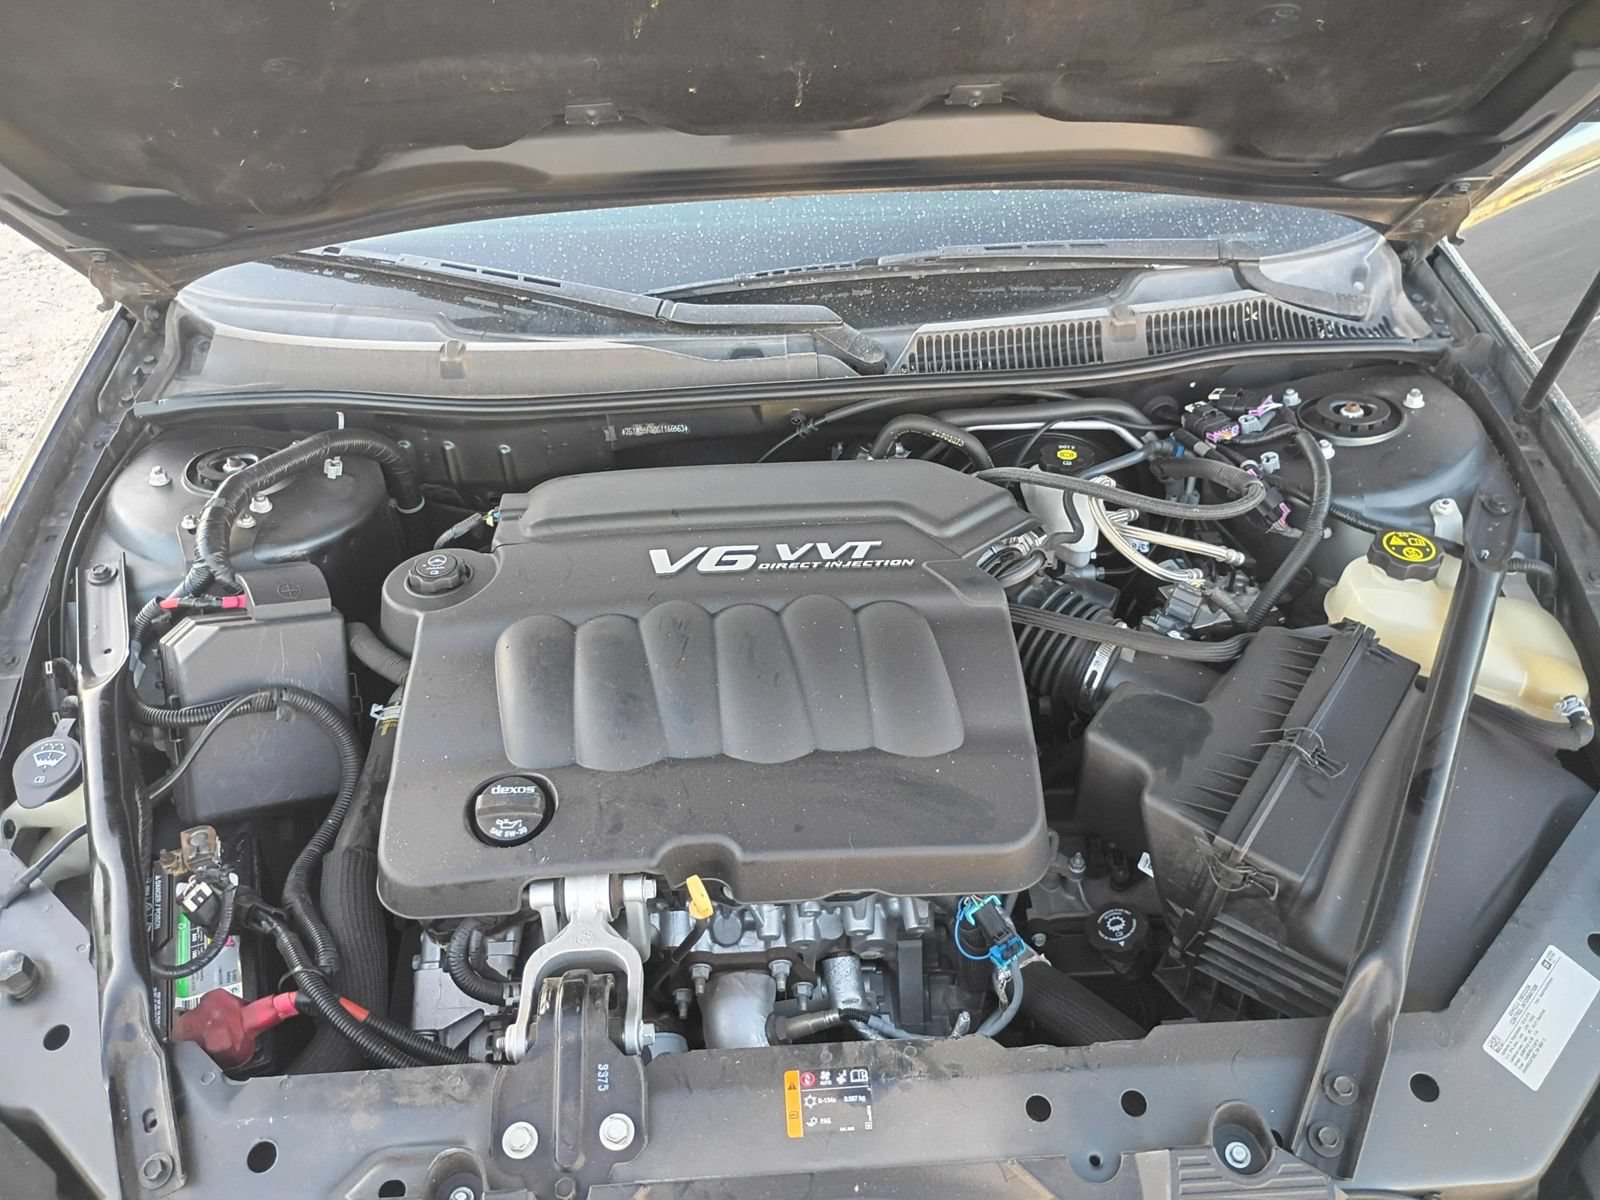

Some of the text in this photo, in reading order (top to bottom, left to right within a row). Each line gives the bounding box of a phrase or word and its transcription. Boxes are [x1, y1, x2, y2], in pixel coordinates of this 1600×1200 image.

[649, 540, 883, 576] V6 VVT
[757, 558, 915, 571] DIRECT INJECTION
[491, 784, 537, 795] dexos
[490, 827, 503, 837] SAE
